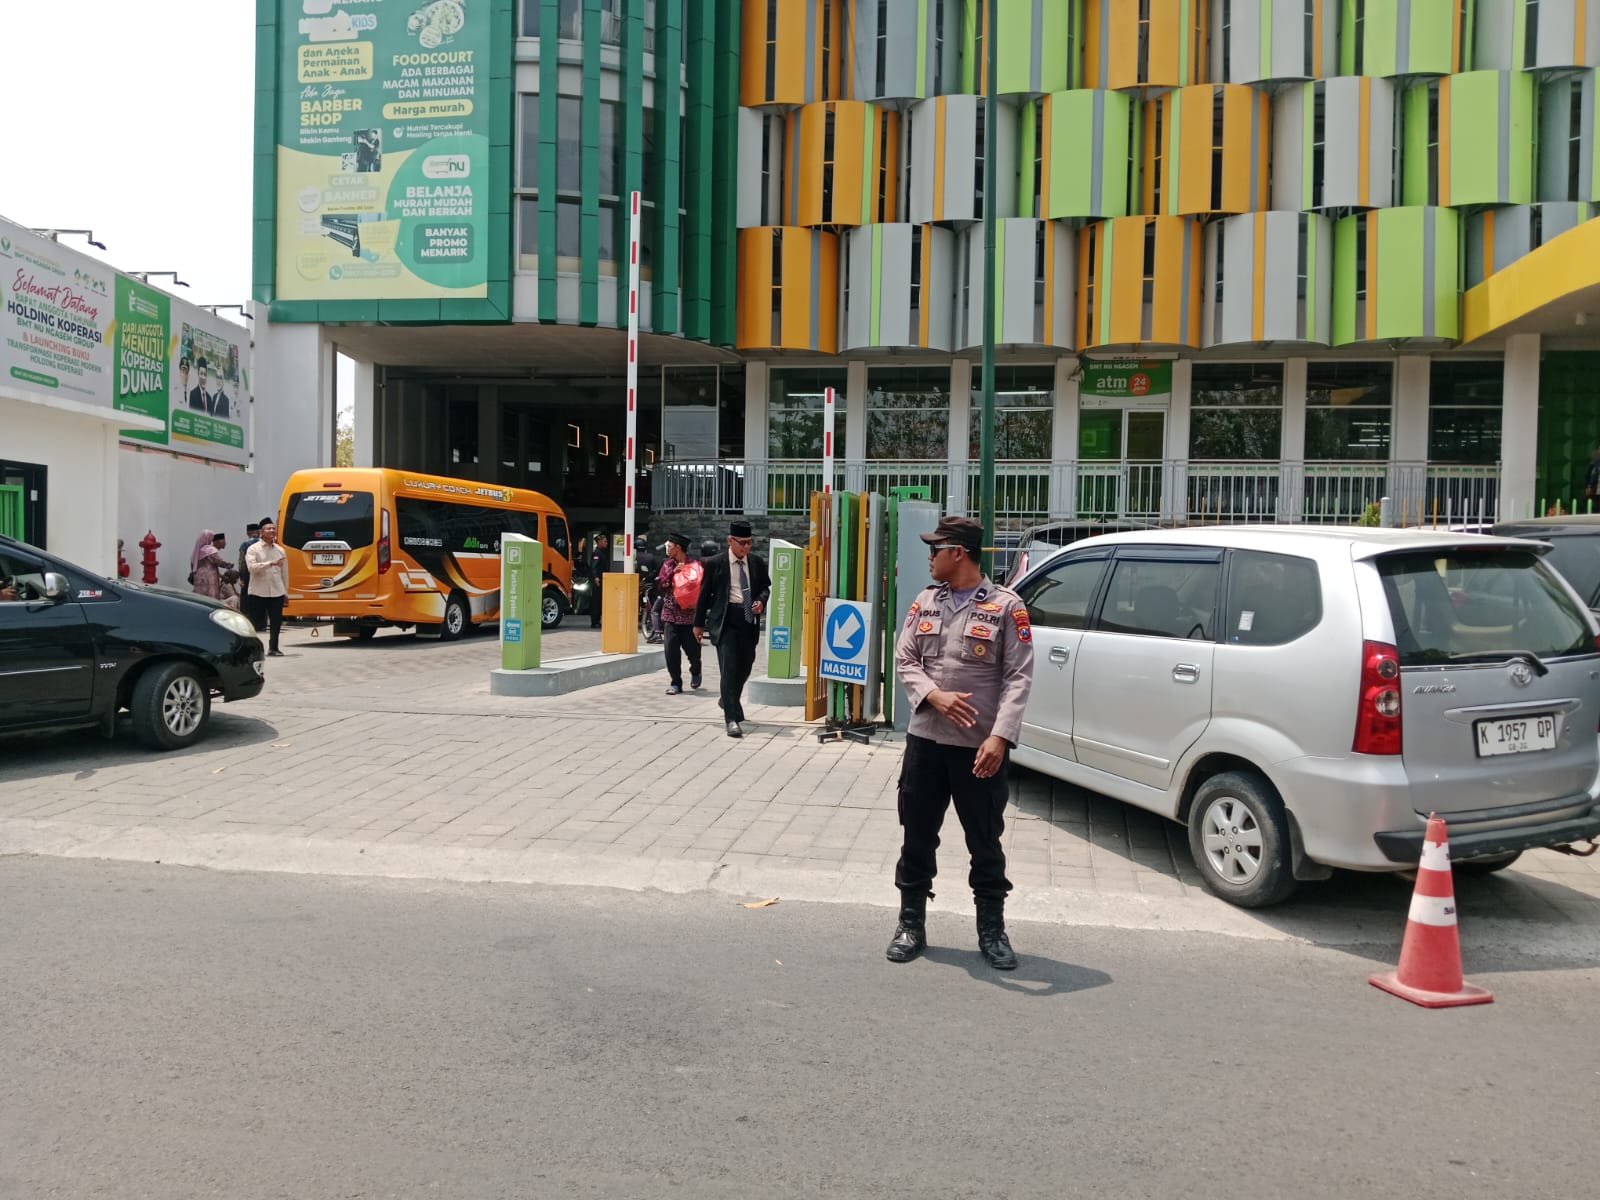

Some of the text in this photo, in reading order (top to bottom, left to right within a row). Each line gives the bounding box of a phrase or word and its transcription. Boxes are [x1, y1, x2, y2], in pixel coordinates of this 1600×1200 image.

[351, 16, 375, 29] KIDS
[303, 46, 360, 58] dan Aneka
[392, 50, 474, 66] FOODCOURT
[303, 56, 360, 68] Permainan
[303, 68, 330, 78] Anak
[340, 66, 367, 76] Anak
[401, 65, 474, 77] ADA BERBAGAI
[382, 76, 474, 89] MACAM MAKANAN
[398, 87, 474, 98] DAN MINUMAN
[300, 98, 362, 113] BARBER
[393, 103, 465, 116] Harga murah
[300, 113, 342, 126] SHOP
[406, 185, 472, 198] BELANJA
[394, 198, 472, 208] MURAH MUDAH
[402, 206, 472, 216] DAN BERKAH
[425, 228, 468, 237] BANYAK
[430, 238, 467, 247] PROMO
[421, 248, 468, 257] MENARIK
[12, 268, 62, 304] Selamat
[61, 287, 98, 320] Datang
[15, 293, 37, 308] RAPAT
[38, 303, 68, 318] ANGGOTA
[8, 300, 102, 344] HOLDING KOPERASI
[17, 317, 94, 349] BMT NU NGASEM GROUP
[122, 322, 164, 336] DARI ANGGOTA
[7, 338, 52, 359] TRANSFORMASI
[30, 334, 71, 354] LAUNCHING
[72, 348, 90, 360] BUKU
[121, 333, 164, 361] MENUJU
[121, 348, 164, 373] KOPERASI
[120, 368, 163, 394] DUNIA
[1096, 376, 1146, 388] atm 24
[404, 479, 441, 490] LUXURY
[442, 484, 472, 494] COACH
[509, 548, 519, 562] P
[778, 555, 788, 568] P
[777, 576, 787, 626] Parking System
[970, 612, 1000, 624] POLRI
[823, 662, 863, 678] MASUK
[1413, 684, 1456, 694] AVANZA
[1480, 720, 1552, 744] K 1957 QP
